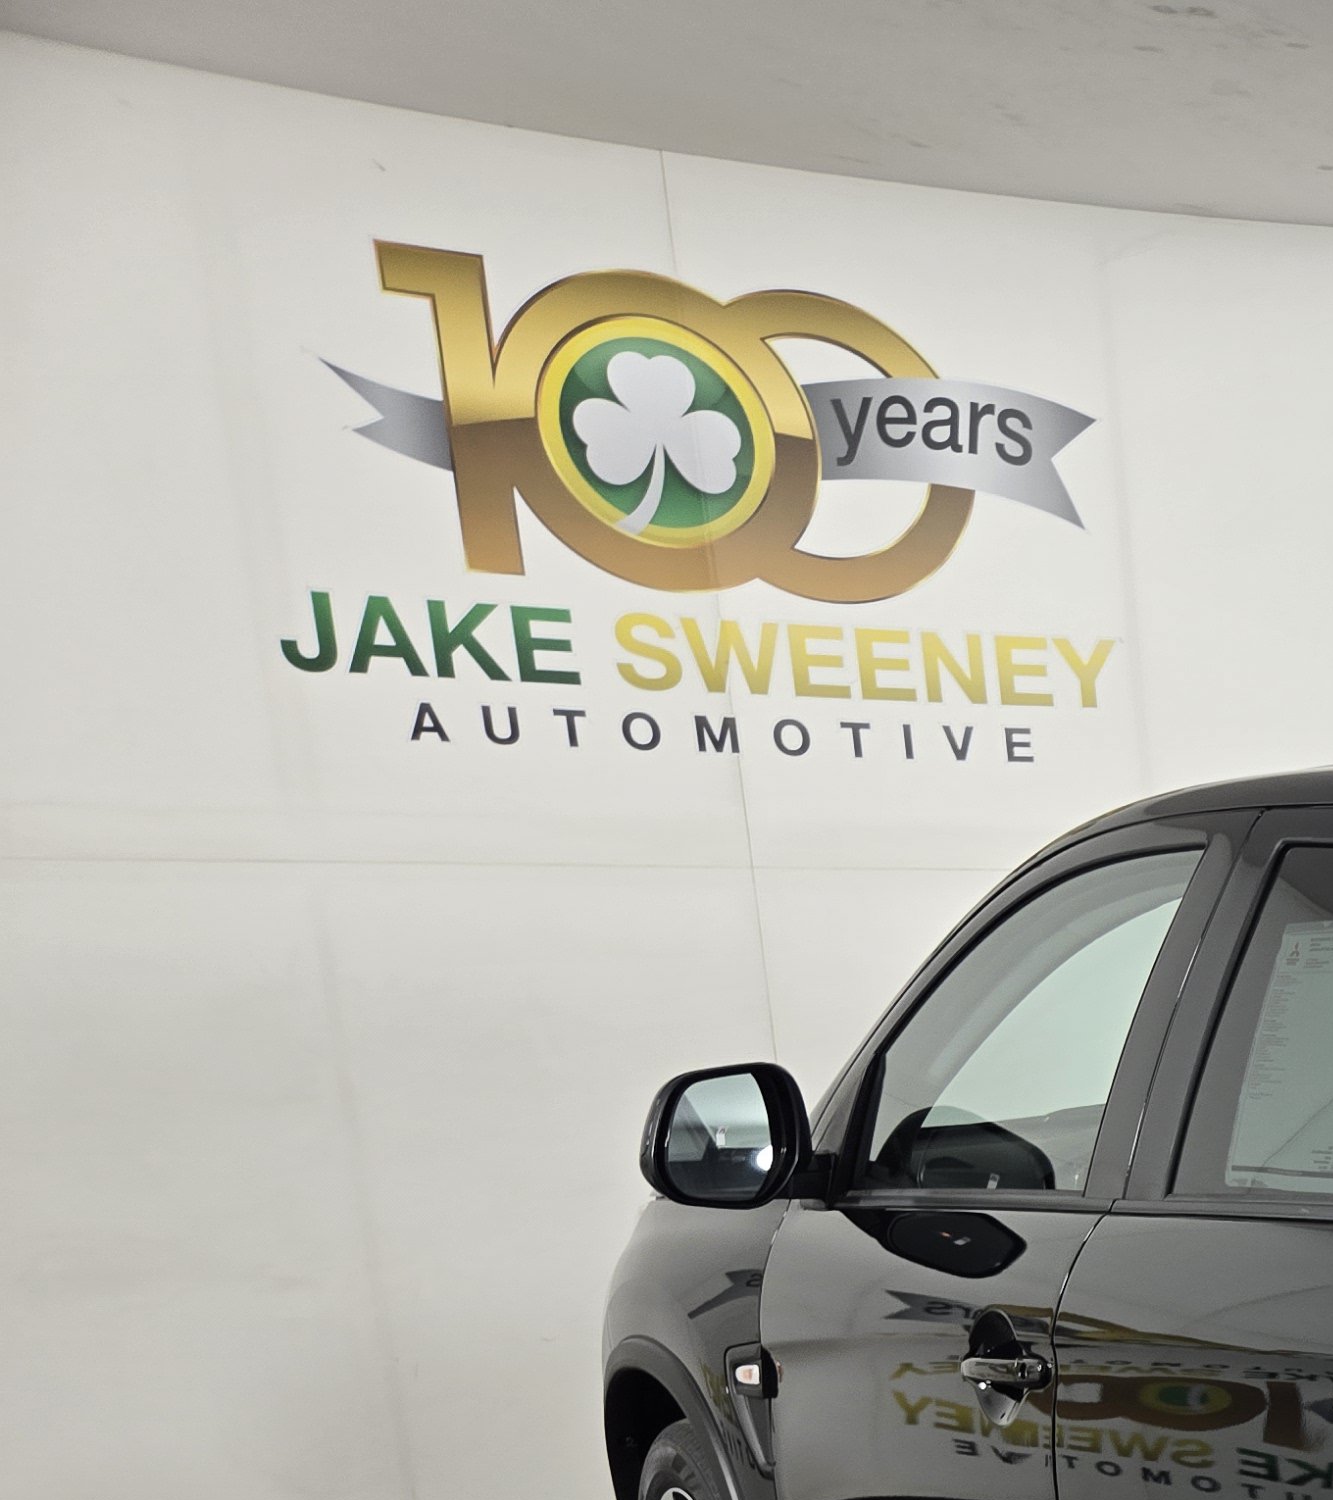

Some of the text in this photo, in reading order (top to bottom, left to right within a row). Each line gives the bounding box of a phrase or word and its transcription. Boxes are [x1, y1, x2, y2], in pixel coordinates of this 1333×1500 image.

[373, 239, 976, 603] 100
[832, 393, 1033, 466] years
[280, 591, 1115, 708] JAKE SWEENEY
[410, 702, 1034, 762] AUTOMOTIVE
